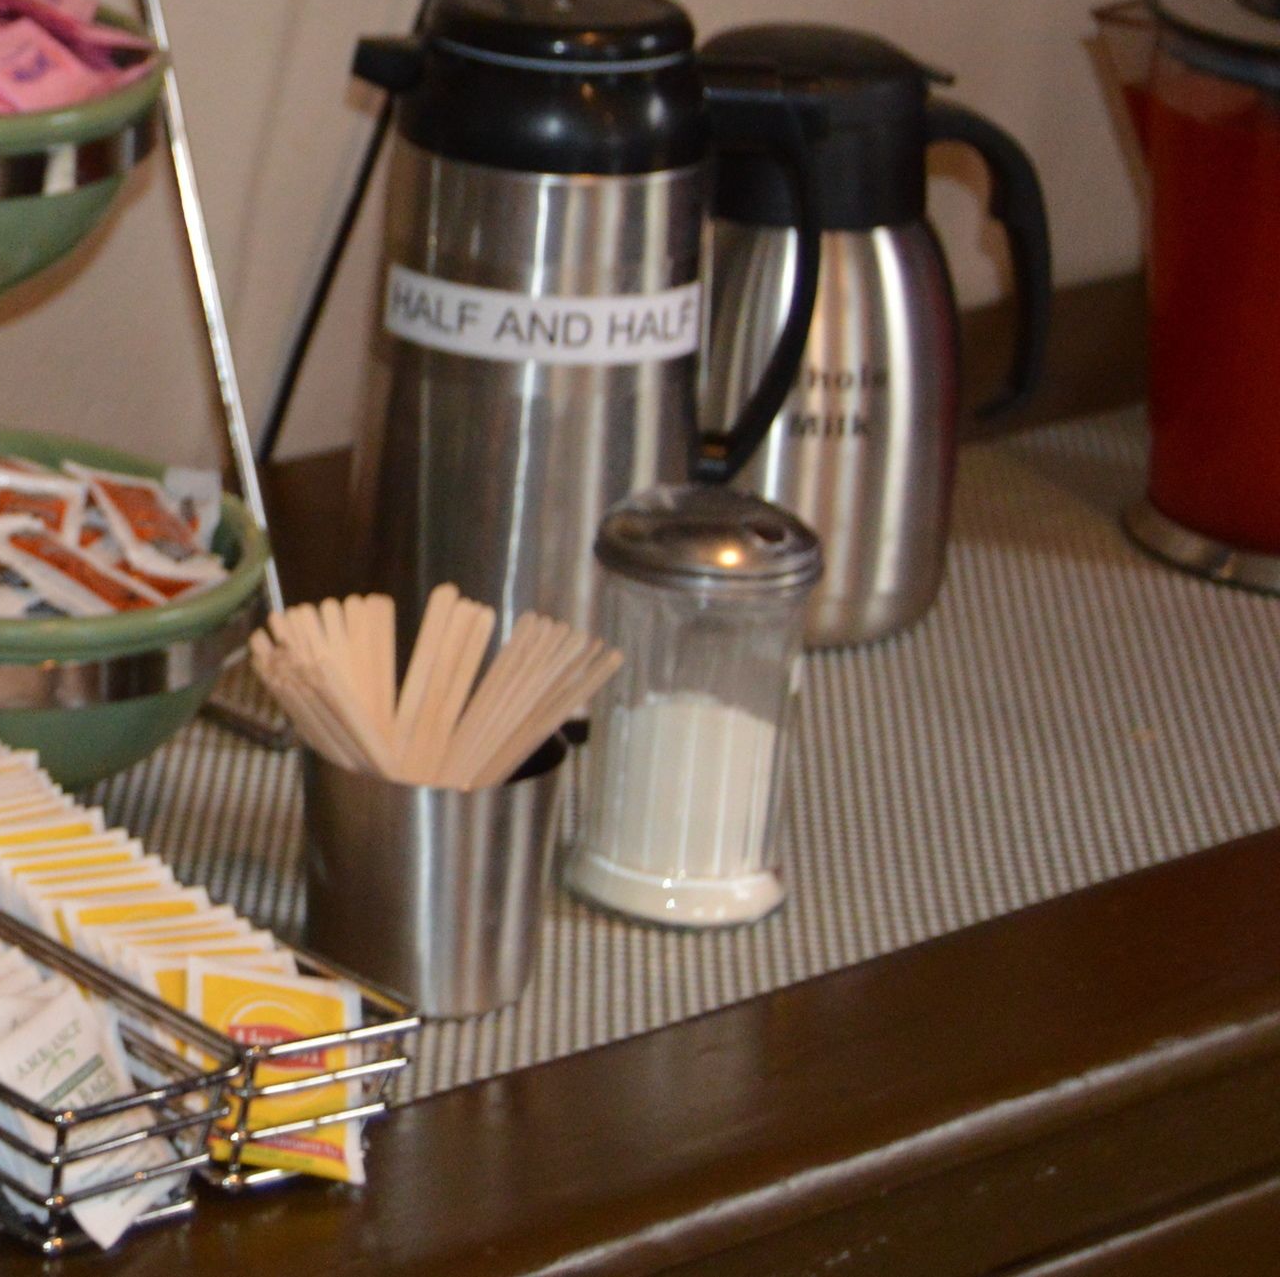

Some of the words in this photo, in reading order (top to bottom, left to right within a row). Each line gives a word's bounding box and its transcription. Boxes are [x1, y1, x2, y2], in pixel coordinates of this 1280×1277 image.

[393, 280, 481, 335] HALF
[493, 306, 593, 348] AND
[607, 298, 695, 347] HALF
[804, 366, 888, 388] hole
